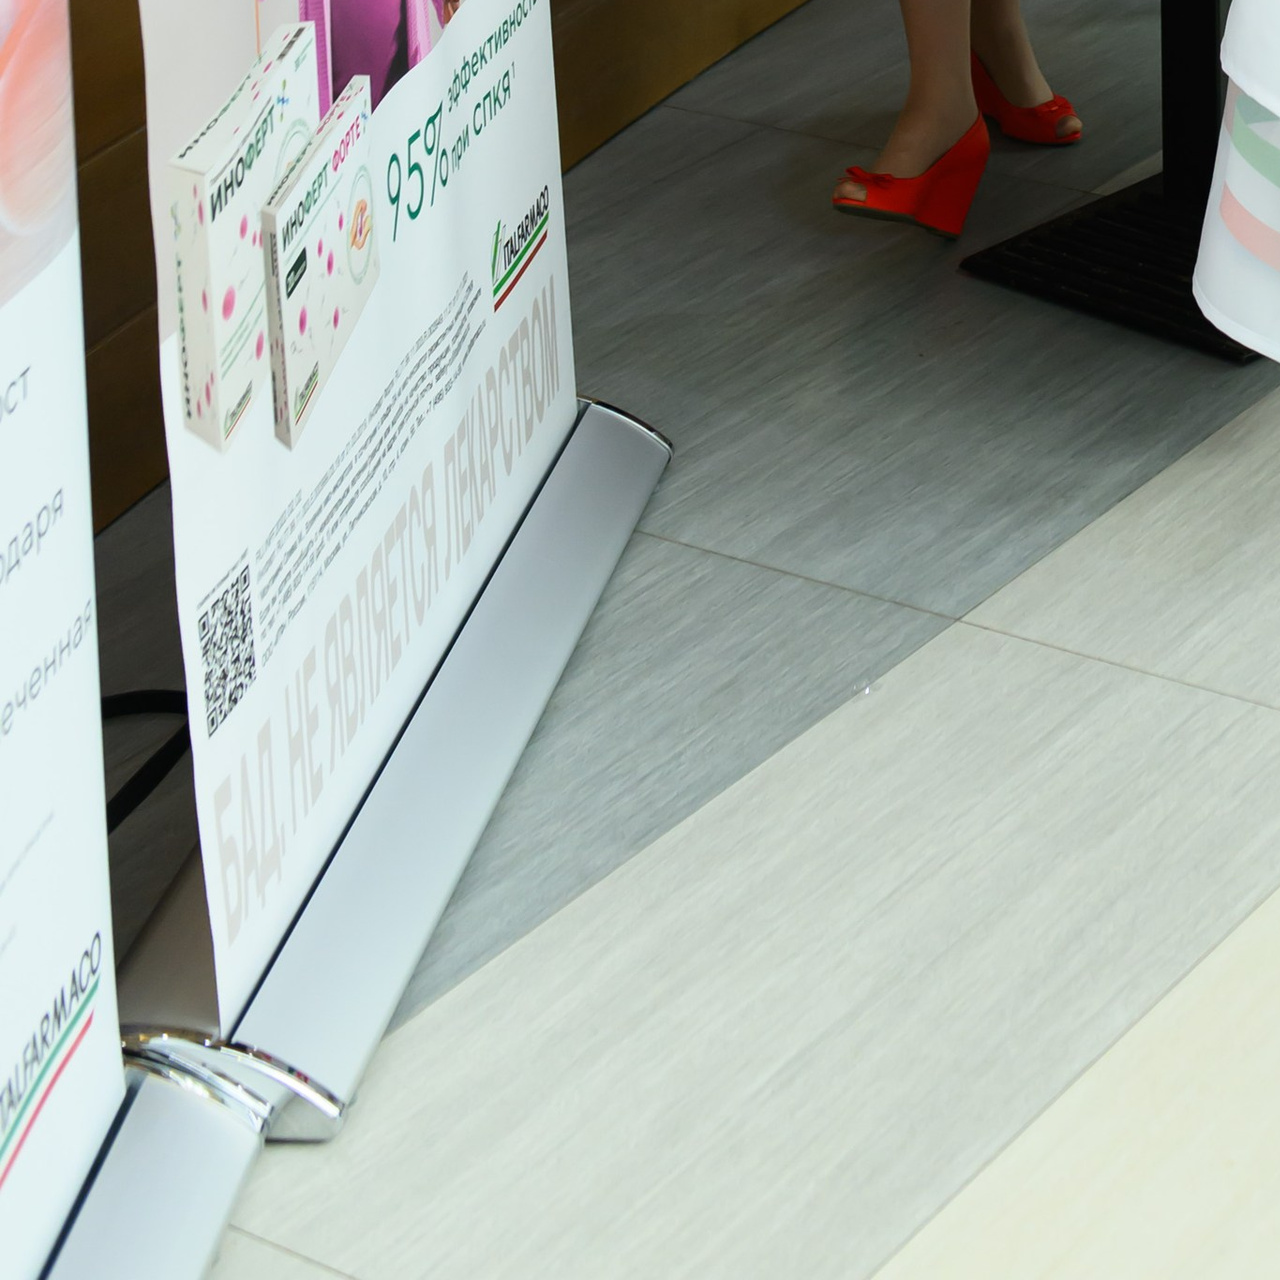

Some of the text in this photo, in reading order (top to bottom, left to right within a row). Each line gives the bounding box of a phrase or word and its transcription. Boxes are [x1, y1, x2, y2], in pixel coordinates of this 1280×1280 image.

[209, 103, 275, 223] ИНОФЕРТ
[282, 162, 329, 252] ИНОФЕРТ
[332, 115, 361, 173] ФОРТЕ
[387, 100, 449, 242] 95%
[451, 123, 470, 175] при
[503, 185, 550, 270] ITALFARMACO
[285, 646, 324, 835] НЕ
[324, 460, 439, 775] ЯВЛЯЕТСЯ
[443, 274, 560, 582] ЛЕКАРСТВОМ
